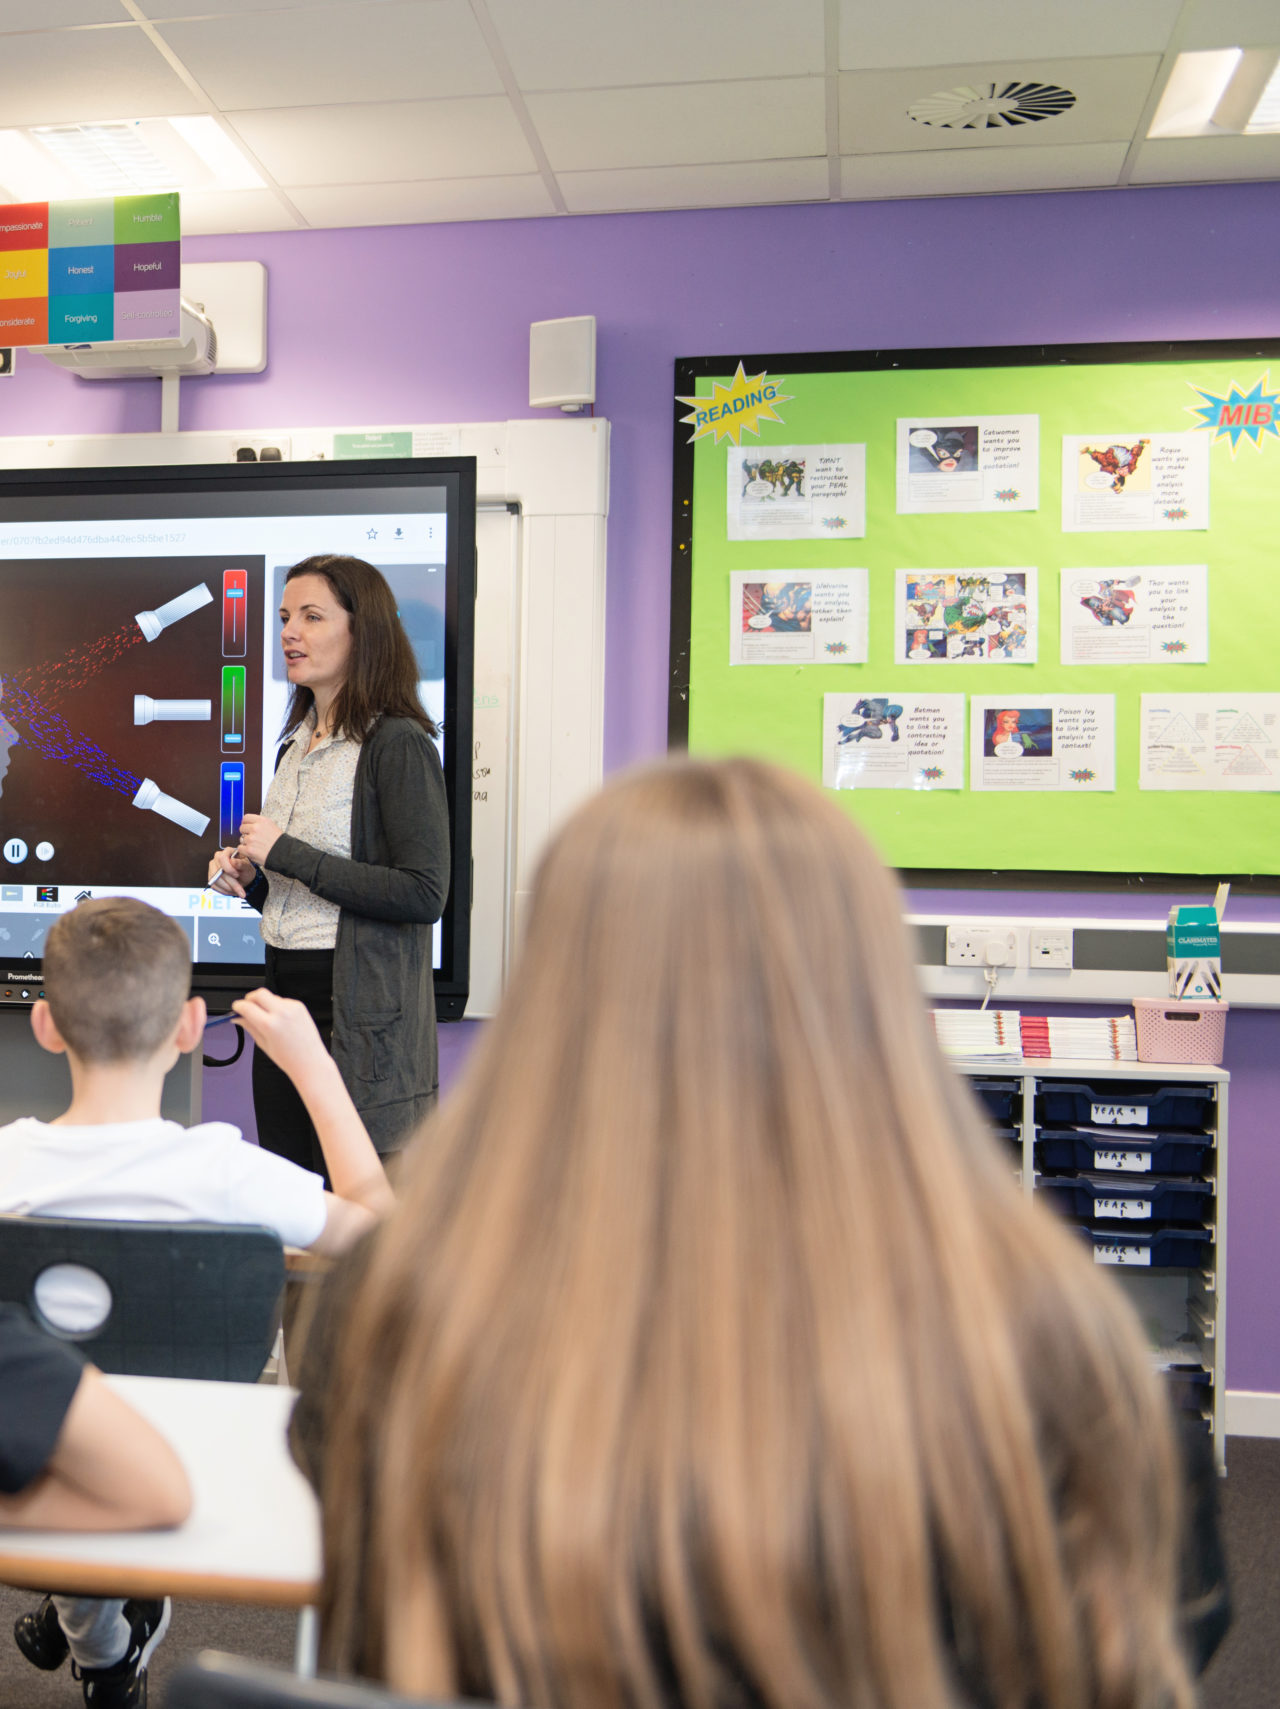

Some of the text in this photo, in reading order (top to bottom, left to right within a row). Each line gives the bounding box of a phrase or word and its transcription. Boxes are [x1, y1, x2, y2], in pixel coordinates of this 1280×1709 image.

[133, 213, 162, 223] Humble
[67, 265, 94, 275] Honest
[133, 262, 162, 272] Hopeful
[4, 269, 27, 280] Joyful
[64, 314, 98, 325] Forgiving
[695, 385, 777, 428] READING
[1218, 403, 1273, 426] MIB
[913, 706, 941, 714] Batman
[1084, 708, 1096, 716] Ivy
[907, 732, 947, 740] contrasting
[1057, 733, 1084, 741] analysis
[907, 748, 945, 757] quotation!
[1094, 1105, 1124, 1116] YEAR
[1097, 1151, 1127, 1161] YEAR
[1097, 1199, 1128, 1210] YEAR
[1096, 1245, 1127, 1255] YEAR
